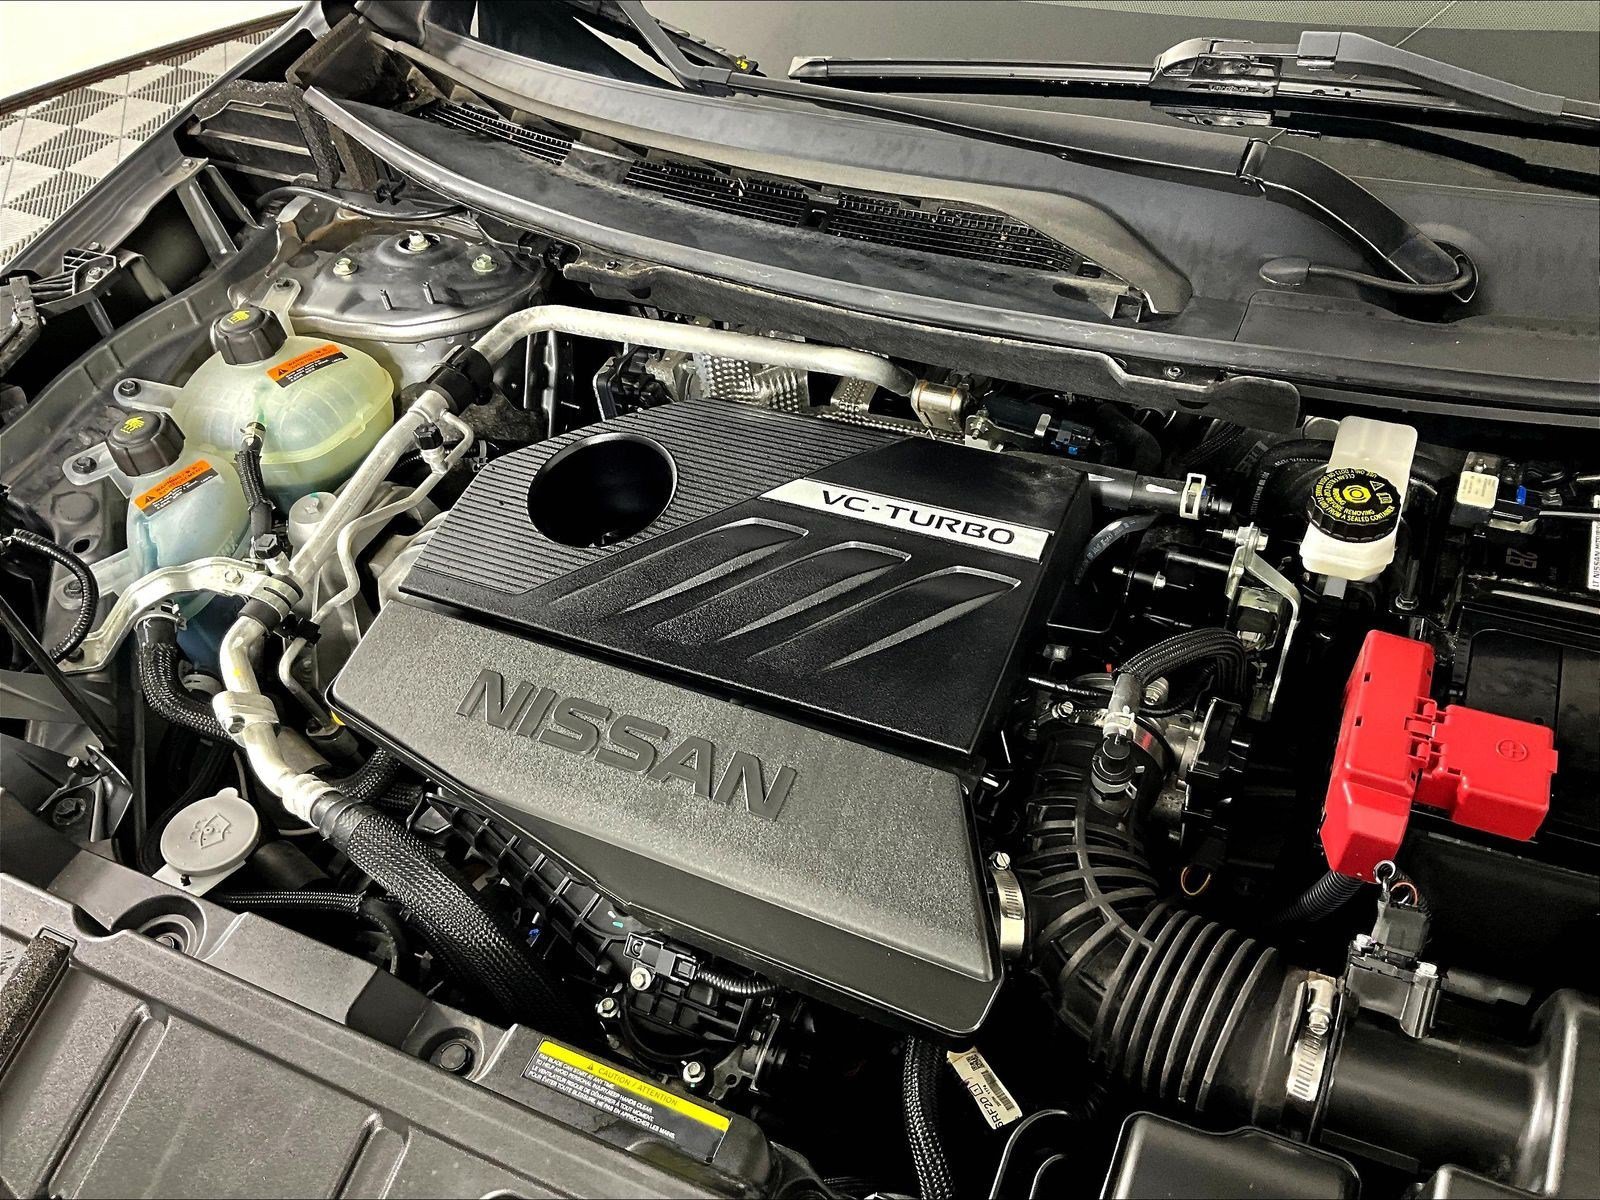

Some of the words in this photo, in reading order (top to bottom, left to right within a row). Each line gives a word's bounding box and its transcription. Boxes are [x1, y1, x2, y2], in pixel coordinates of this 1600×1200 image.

[822, 490, 1015, 545] VC-TURBO
[455, 669, 798, 821] NISSAN
[599, 1068, 630, 1085] CAUTION
[637, 1084, 677, 1106] ATTENTION
